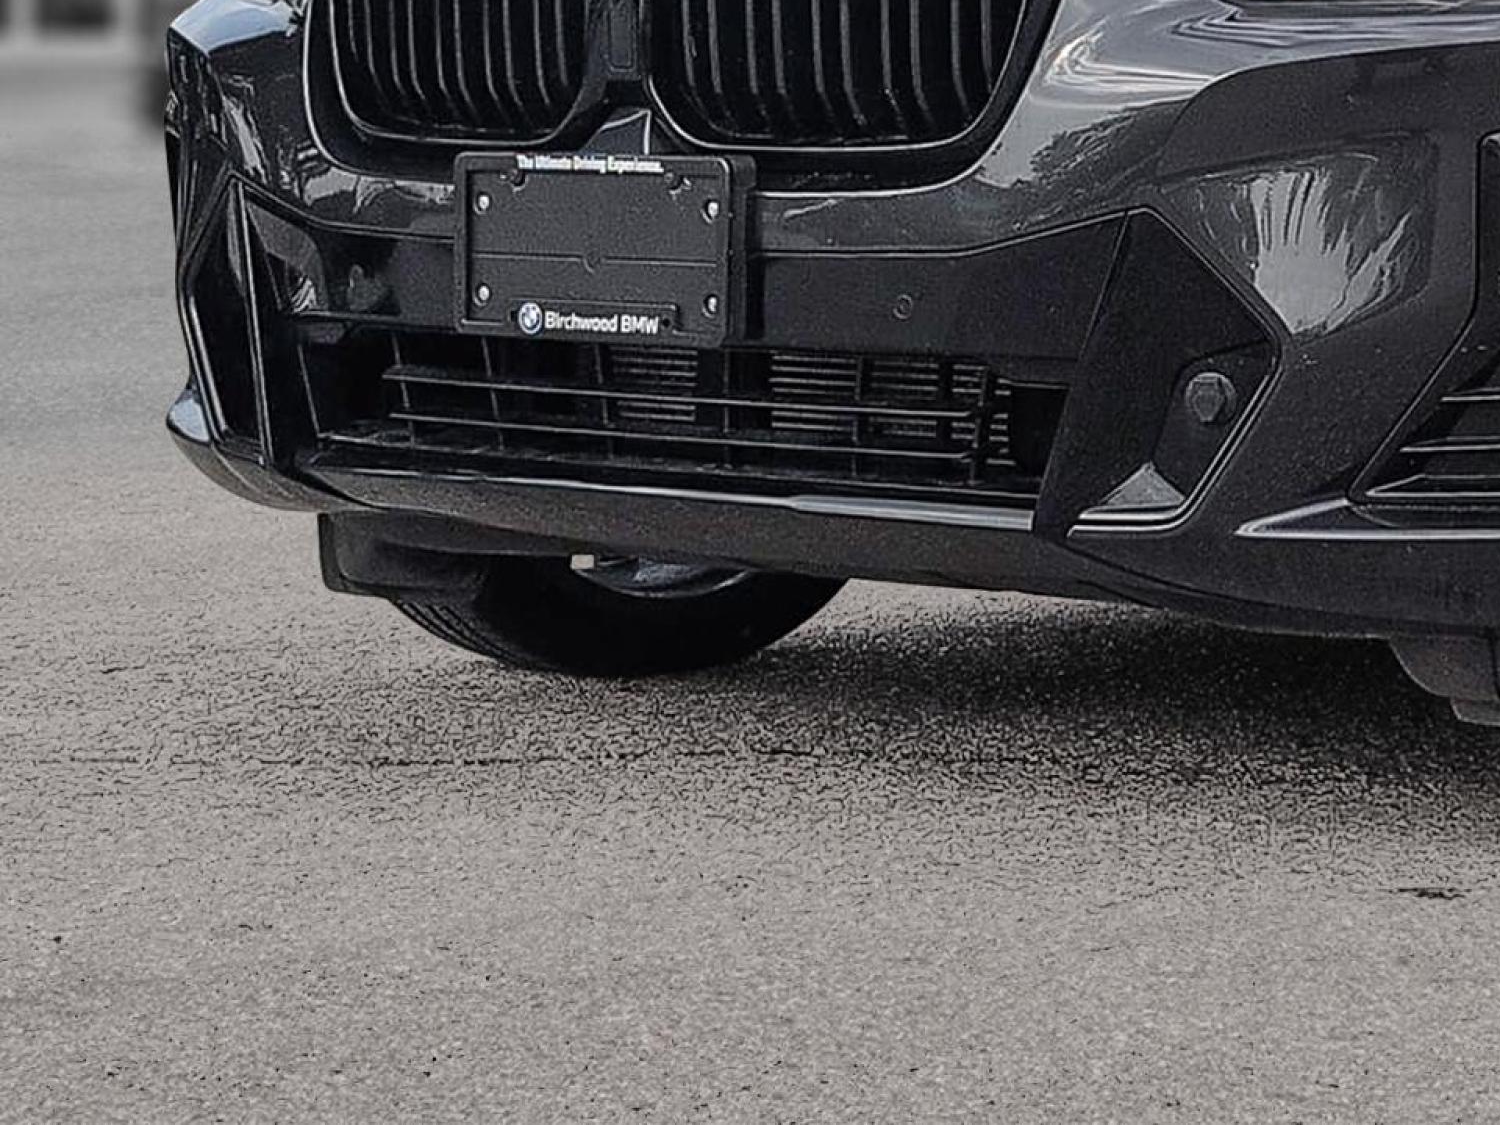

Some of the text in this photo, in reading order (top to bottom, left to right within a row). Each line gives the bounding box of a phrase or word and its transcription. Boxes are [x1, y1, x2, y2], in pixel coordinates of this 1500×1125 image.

[573, 155, 606, 174] Driving
[545, 310, 659, 335] Birchwood BMW
